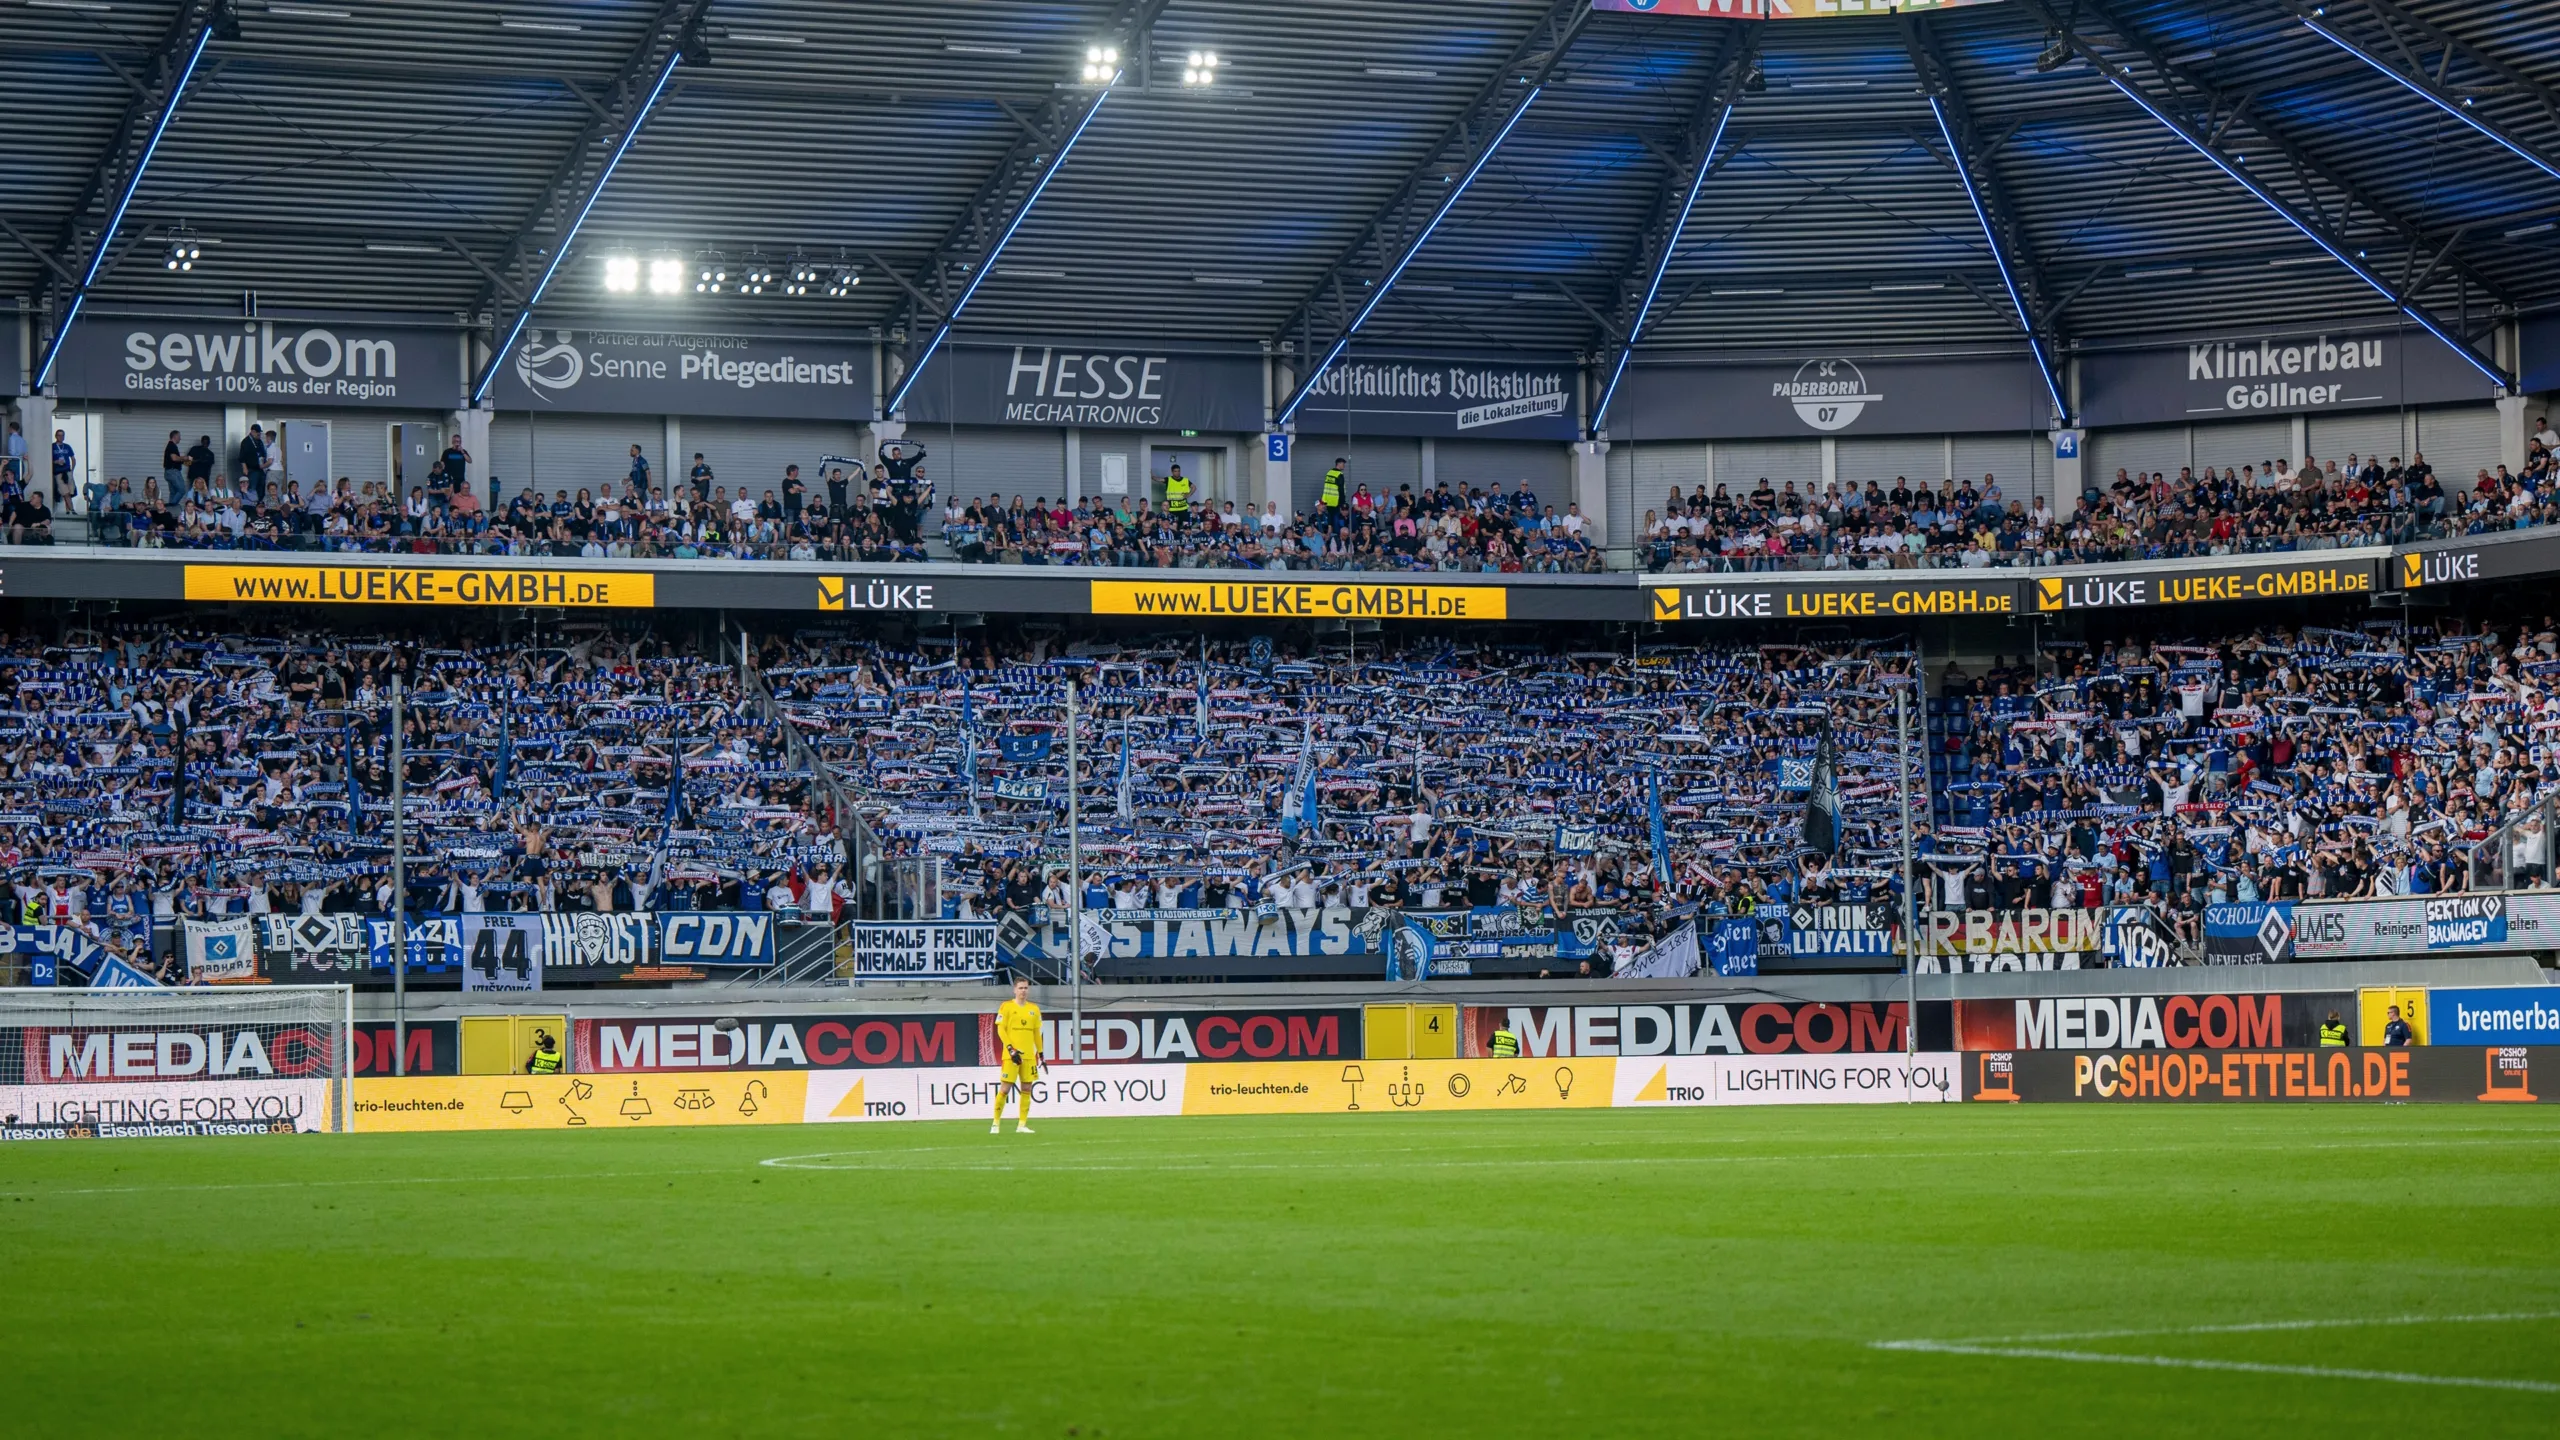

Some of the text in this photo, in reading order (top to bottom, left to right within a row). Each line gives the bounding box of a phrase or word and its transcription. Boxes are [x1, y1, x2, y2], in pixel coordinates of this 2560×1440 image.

[125, 322, 397, 377] sewikOm
[2188, 335, 2382, 381] Klinkerbau
[589, 352, 853, 389] Senne Pflegedienst
[1006, 346, 1167, 400] HESSE
[1819, 361, 1838, 377] SC
[125, 374, 396, 400] Glasfaser 100% aus der Region
[1772, 380, 1859, 397] PADERBORN
[2226, 382, 2342, 411] Göllner
[1006, 401, 1161, 426] MECHATRONICS
[1461, 396, 1560, 425] die Lokalzeitung
[1817, 407, 1839, 424] 07
[1272, 440, 1284, 457] 3
[2060, 436, 2073, 454] 4
[2424, 552, 2479, 583] LÜKE
[849, 578, 933, 610] LÜKE
[2067, 569, 2368, 606] LÜKE LUEKE-GMBH.DE
[1687, 588, 2012, 618] LÜKE LUEKE-GMBH.DE
[483, 916, 515, 928] FREE
[1117, 910, 1217, 920] SEKTION STADIONVERBOT
[1576, 908, 1617, 916] HAMBURG
[1814, 906, 1866, 930] IRON
[2207, 906, 2263, 925] SCHOLL!
[665, 916, 768, 957] CDN
[856, 927, 995, 950] NIEMALS FREUND
[1042, 906, 1350, 959] CSTAWAYS
[2292, 912, 2345, 943] LMES
[2374, 921, 2422, 938] Reinigen
[471, 929, 532, 981] 44
[1793, 931, 1891, 954] LOYALTY
[856, 950, 996, 972] NIEMALS HELFER
[2407, 1000, 2414, 1017] 5
[1429, 1016, 1438, 1032] 4
[1508, 1003, 1908, 1057] MEDIACOM
[2016, 994, 2282, 1050] MEDIACOM
[535, 1028, 545, 1045] 3
[600, 1020, 956, 1068] MEDIACOM
[49, 1028, 433, 1078] MEDIACOM
[1990, 1053, 2012, 1062] PCSHOP
[2499, 1048, 2527, 1058] PCSHOP
[1210, 1082, 1309, 1097] trio-leuchten.de
[1667, 1067, 1947, 1101] TRIO LIGHTING FOR YOU
[32, 1095, 303, 1123] LIGHTING FOR YOU
[354, 1098, 464, 1113] trio-leuchten.de
[865, 1102, 905, 1117] TRIO
[1057, 1081, 1106, 1103] FOR
[1114, 1079, 1165, 1101] YOU
[98, 1121, 195, 1138] Eisenbach
[198, 1119, 294, 1137] Tresore.de
